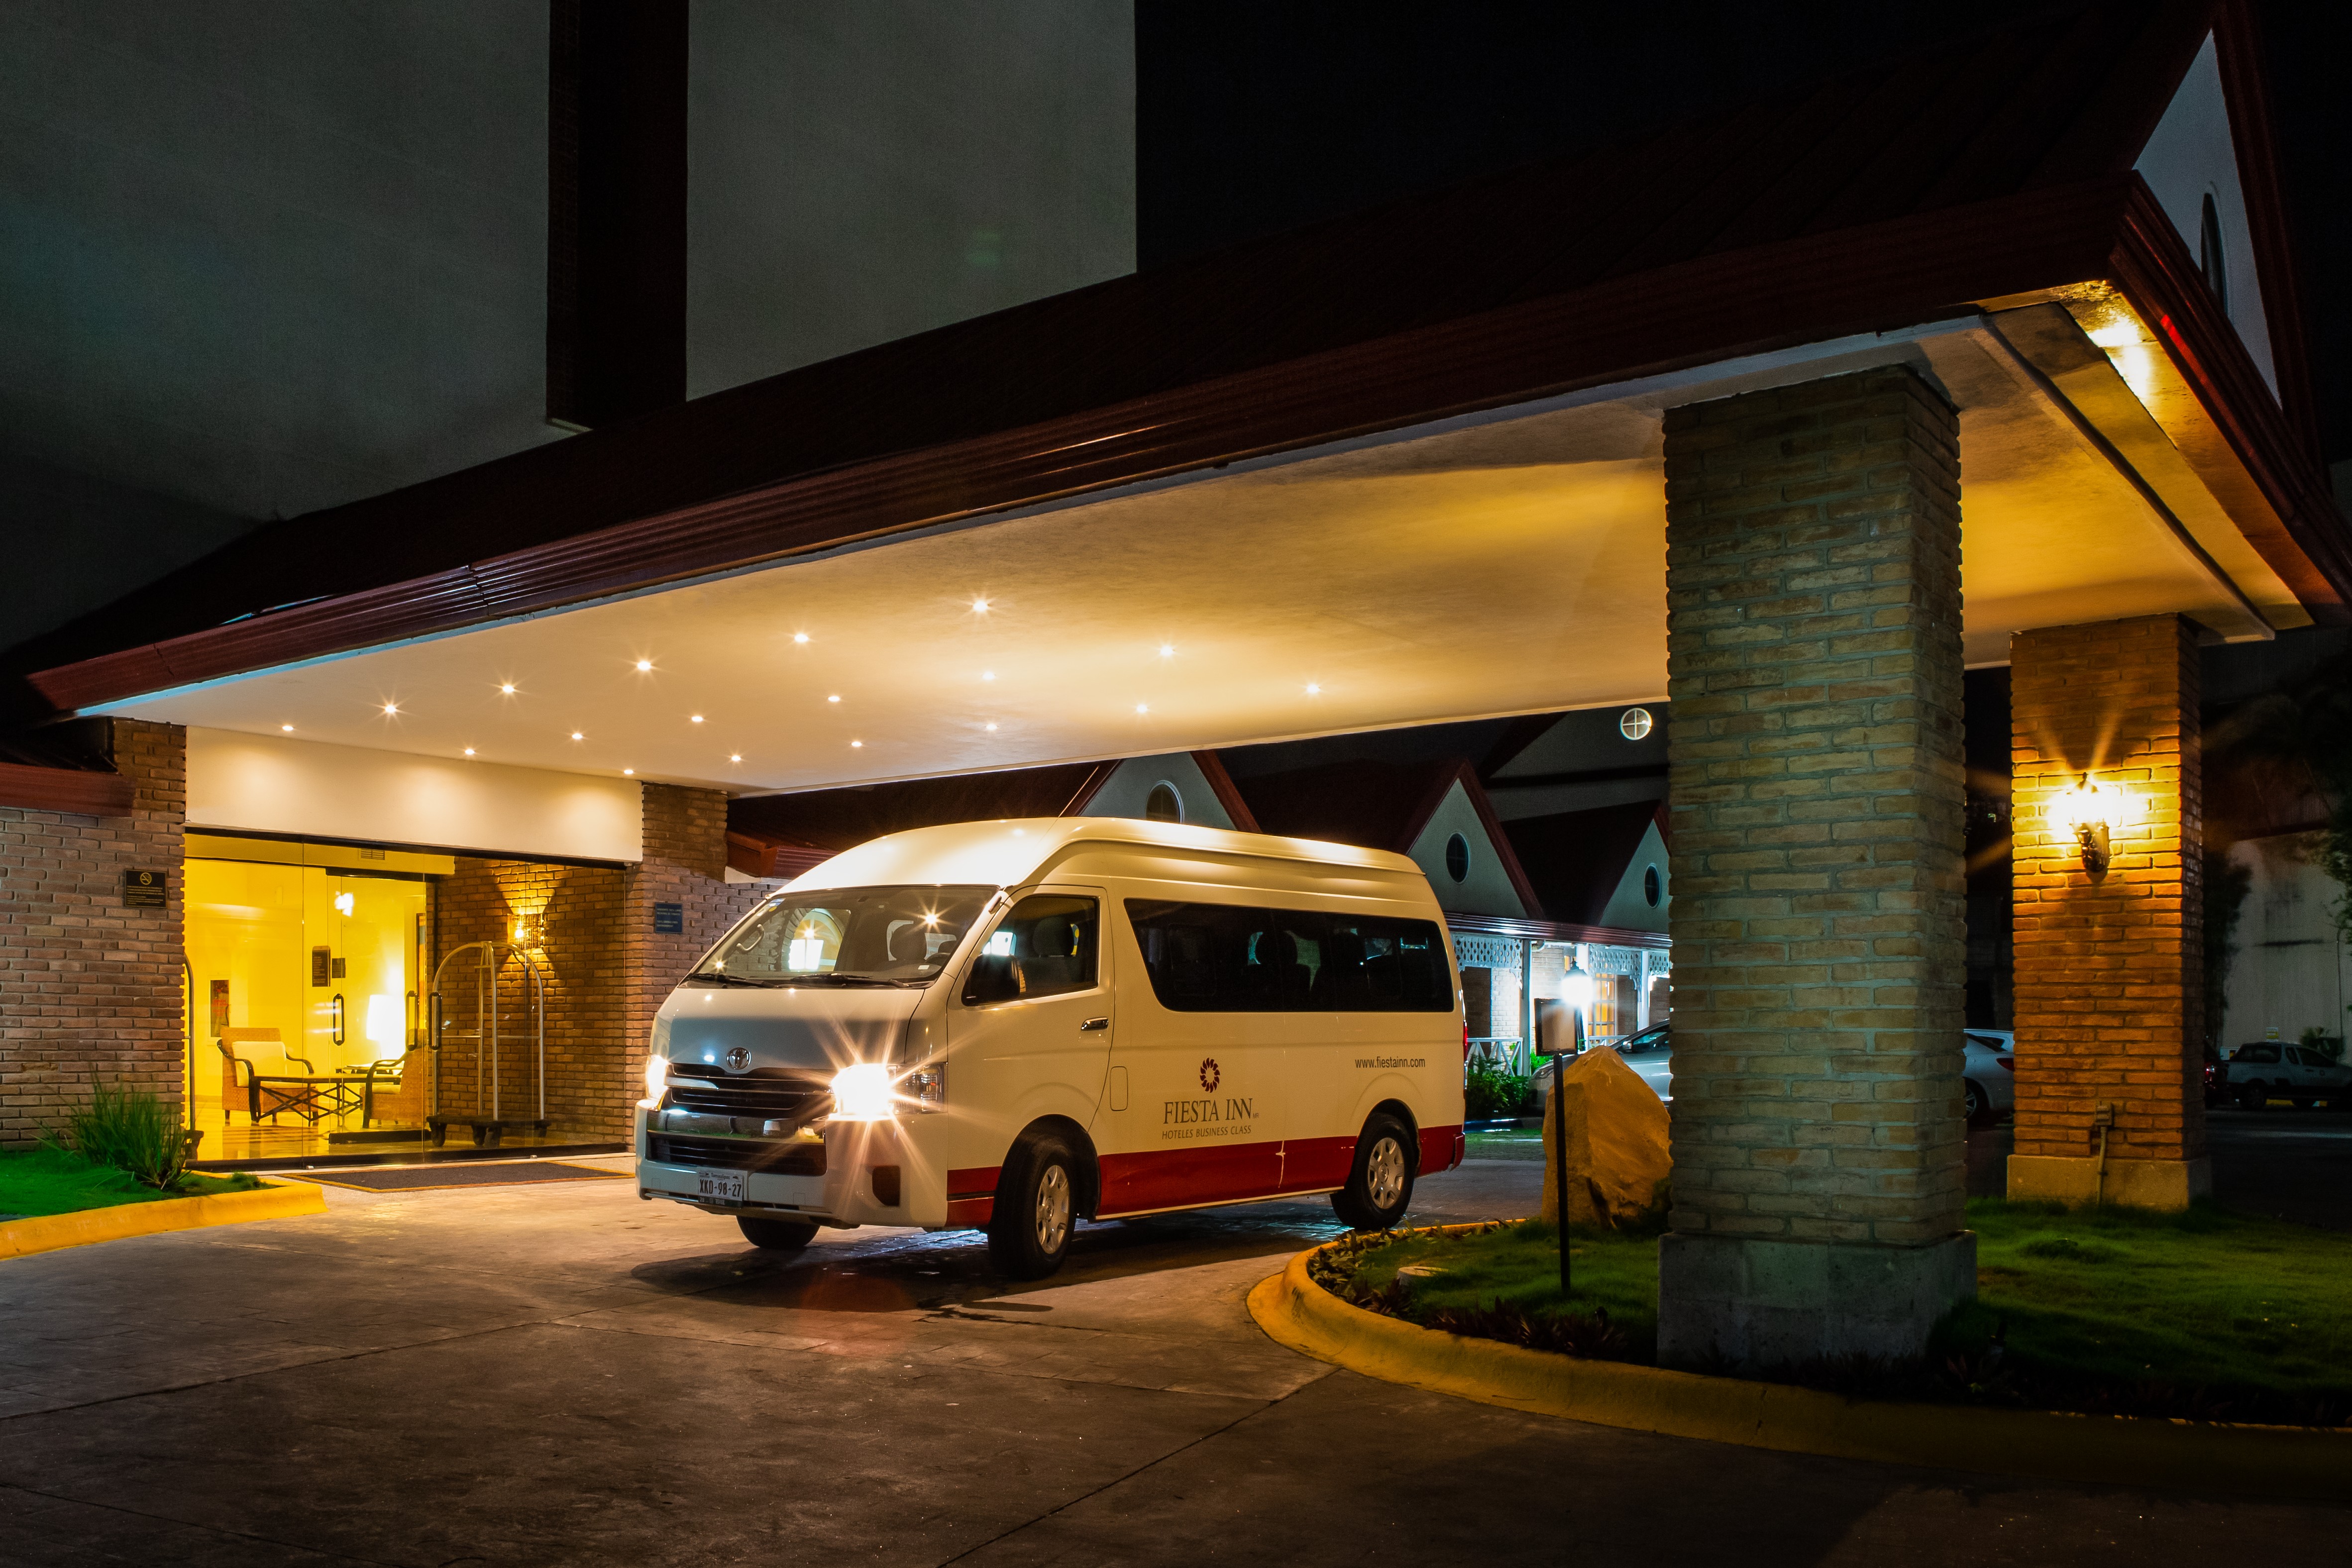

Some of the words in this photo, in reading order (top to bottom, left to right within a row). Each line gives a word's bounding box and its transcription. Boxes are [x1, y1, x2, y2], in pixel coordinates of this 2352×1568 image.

[1355, 1056, 1426, 1068] www.fiestainn.com
[1163, 1100, 1219, 1124] FIESTA
[1225, 1098, 1253, 1121] INN
[1162, 1129, 1193, 1140] HOTELES
[1195, 1126, 1228, 1138] BUSINESS
[1230, 1125, 1252, 1135] CLASS
[699, 1179, 742, 1197] XKD-98-27
